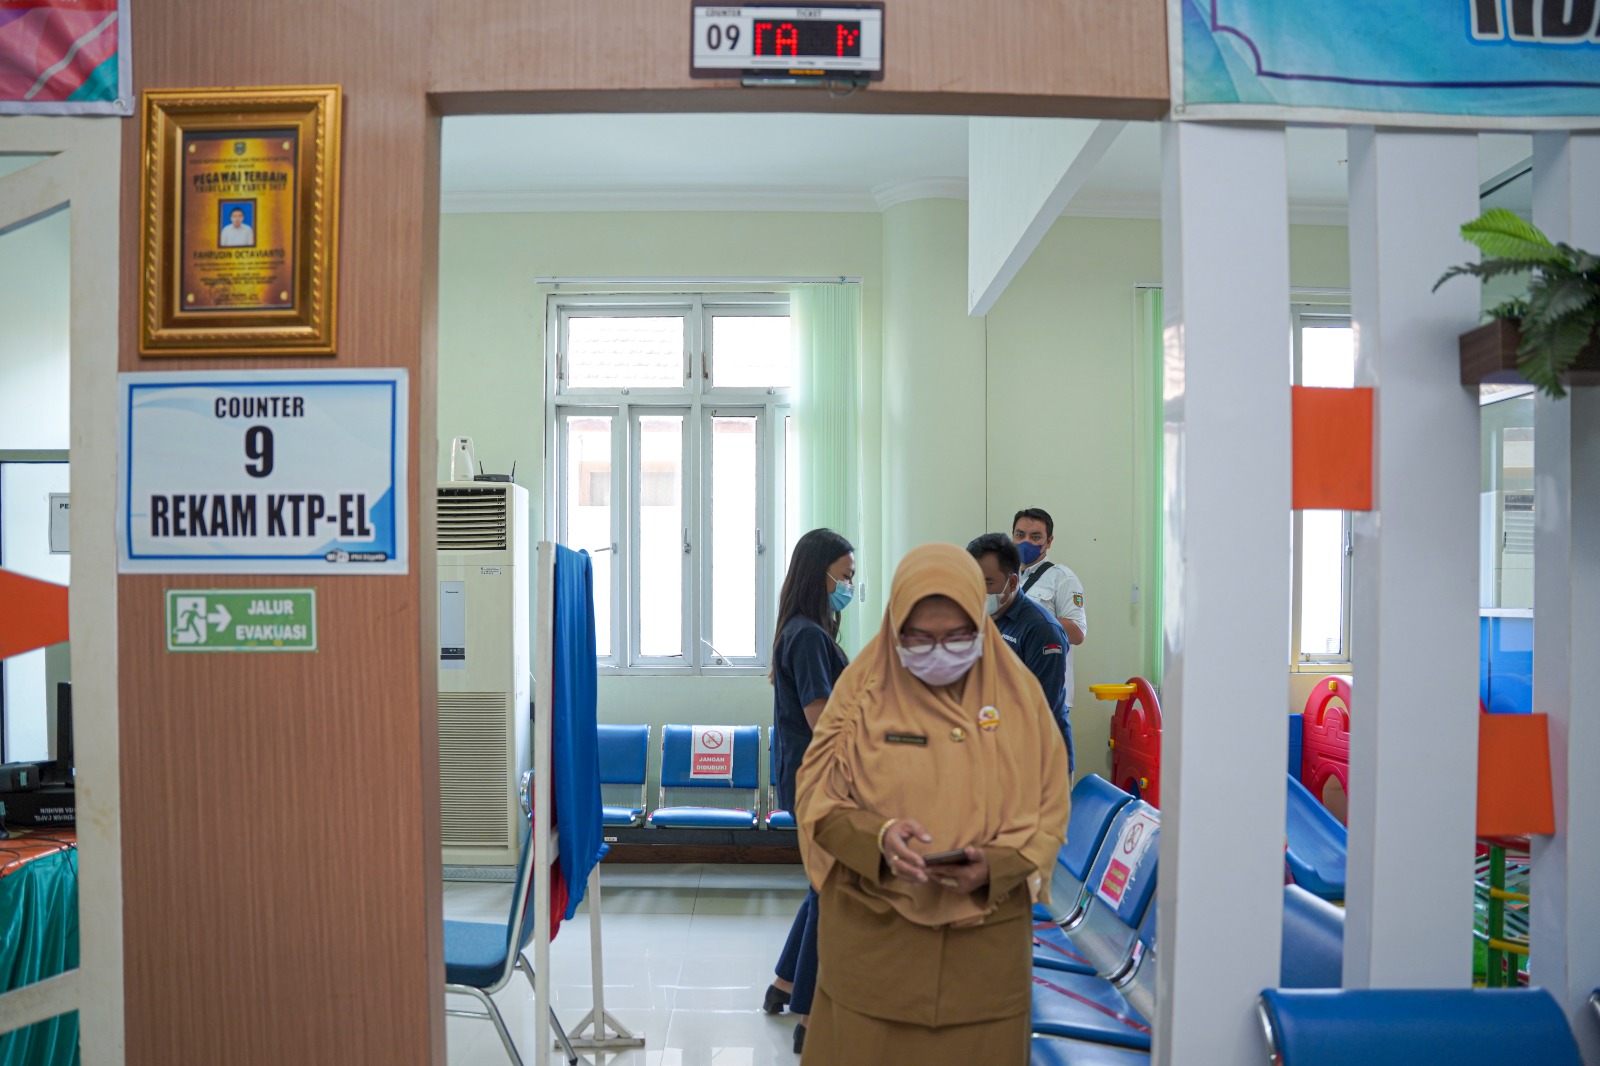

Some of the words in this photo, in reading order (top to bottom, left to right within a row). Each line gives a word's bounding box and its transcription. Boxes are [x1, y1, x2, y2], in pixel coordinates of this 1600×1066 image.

[706, 8, 742, 17] COUNTER
[796, 9, 822, 18] TICKET
[707, 24, 740, 51] 09
[193, 172, 241, 185] PEGAWAI
[214, 396, 305, 419] COUNTER
[244, 424, 275, 478] 9
[151, 494, 257, 537] REKAM
[267, 494, 371, 537] KTP-EL
[247, 599, 294, 615] JALUR
[235, 625, 307, 641] EVAKUASI
